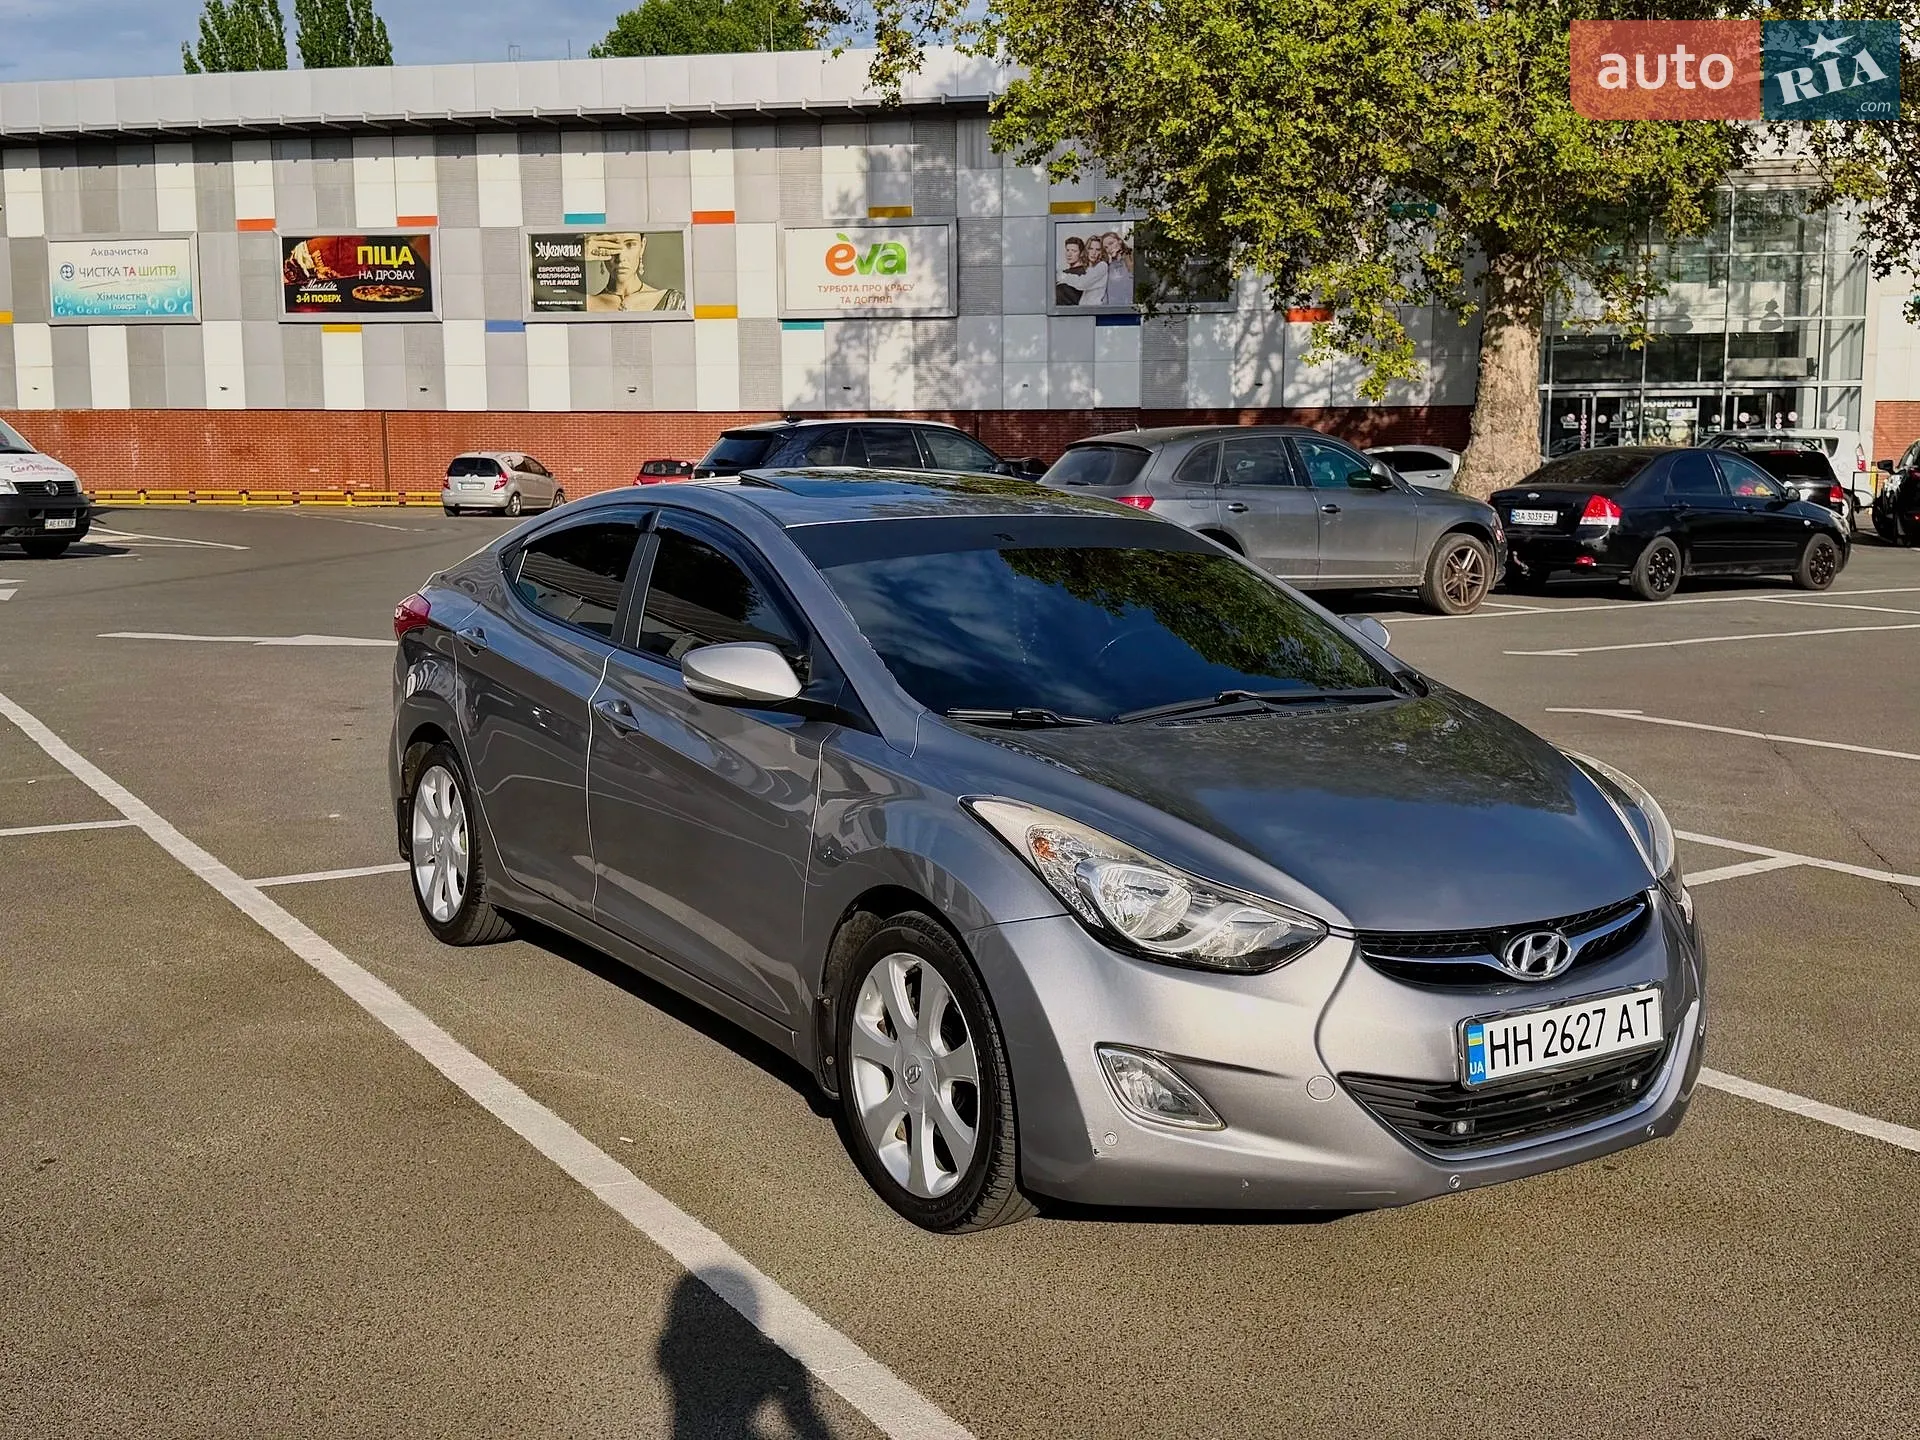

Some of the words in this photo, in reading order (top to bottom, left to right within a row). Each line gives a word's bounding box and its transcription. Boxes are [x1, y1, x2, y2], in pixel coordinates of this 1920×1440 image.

[91, 248, 149, 257] Аквачистка
[357, 245, 415, 268] ПІЦА
[79, 267, 121, 278] ЧИСТКА
[122, 266, 136, 277] ТА
[138, 265, 177, 277] ШИТТЯ
[358, 270, 374, 280] НА
[375, 270, 415, 281] ДРОВАХ
[818, 285, 859, 293] ТУРБОТА
[861, 284, 882, 293] ПРО
[884, 283, 915, 292] КРАСУ
[97, 292, 147, 301] Хімчистка
[296, 292, 310, 303] 3-Й
[311, 294, 342, 303] ПОВЕРХ
[840, 296, 852, 304] ТА
[854, 295, 893, 305] ДОГЛЯД
[1489, 1023, 1533, 1070] HH
[1542, 1008, 1606, 1059] 2627
[1617, 997, 1654, 1043] AT
[1469, 1062, 1485, 1075] UA
